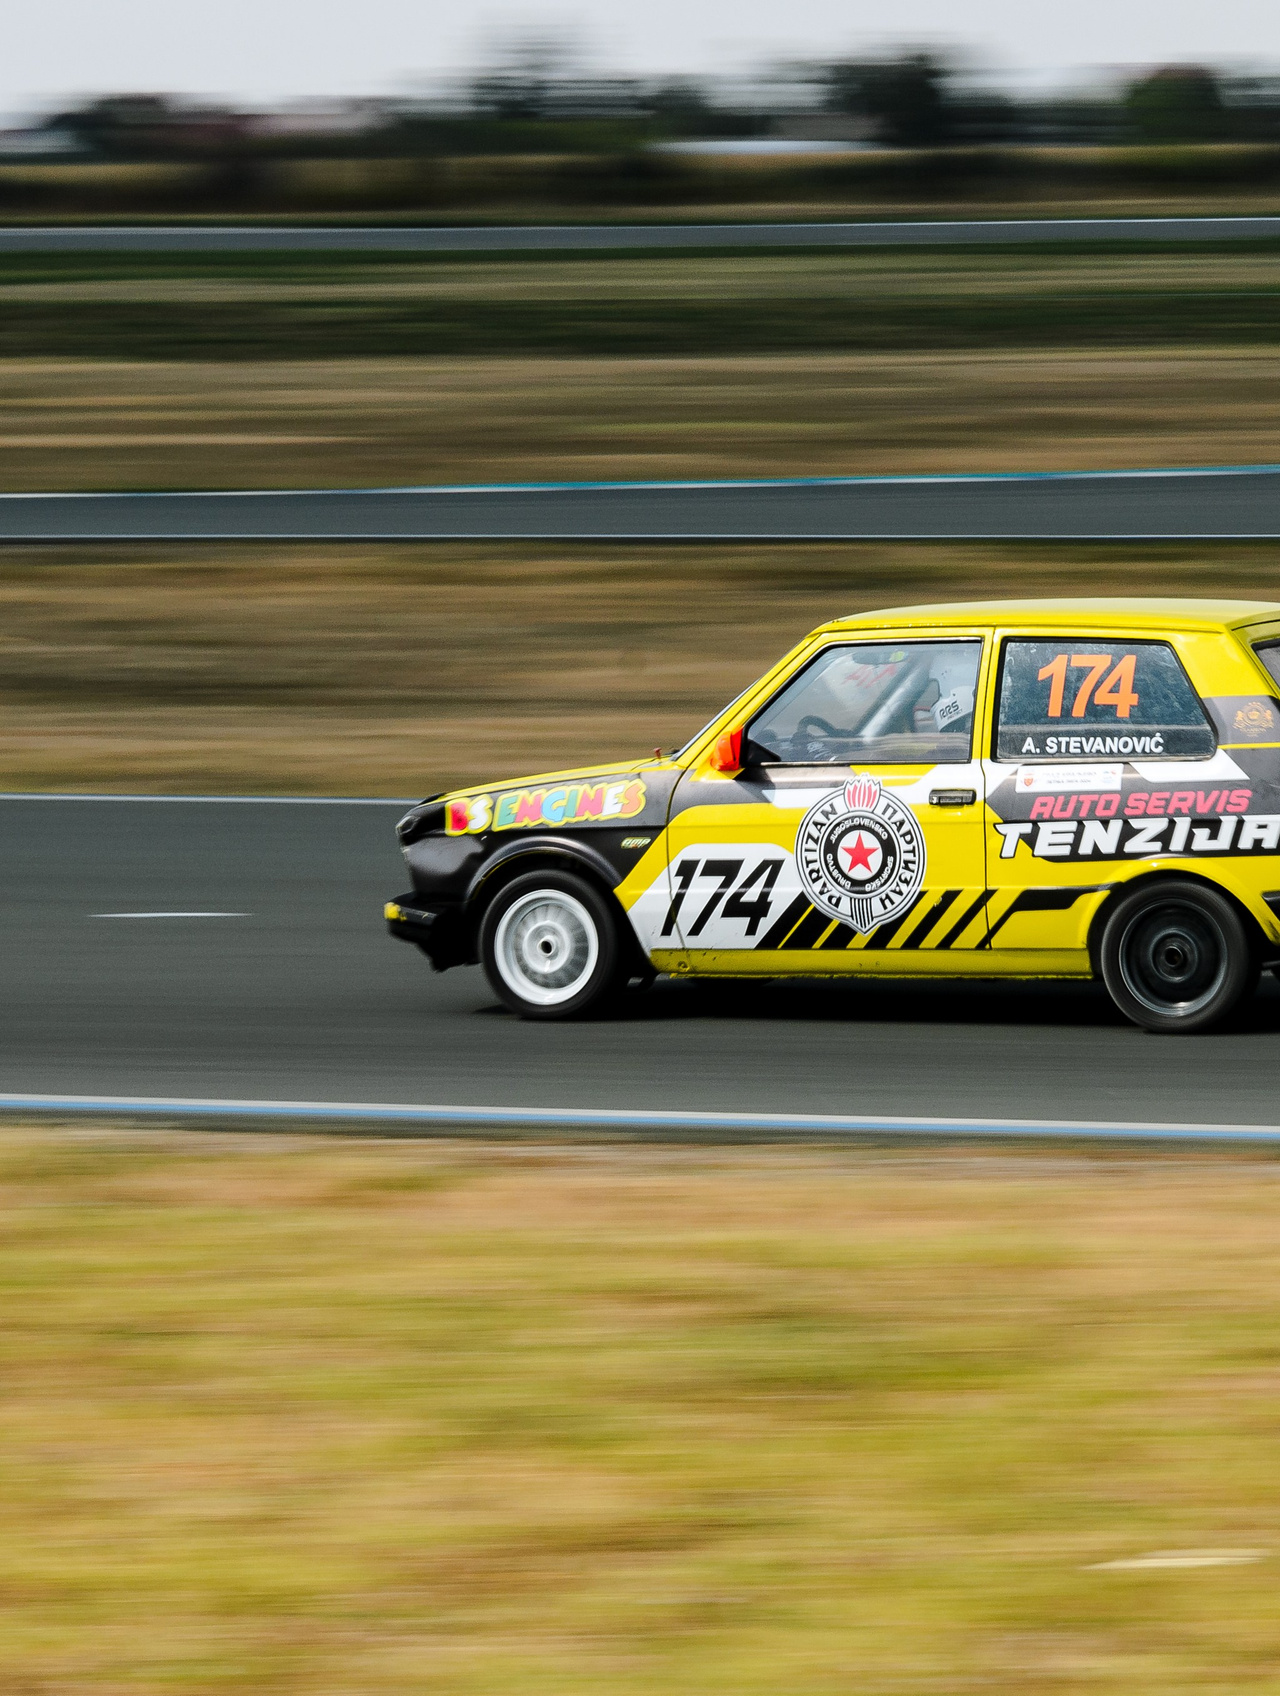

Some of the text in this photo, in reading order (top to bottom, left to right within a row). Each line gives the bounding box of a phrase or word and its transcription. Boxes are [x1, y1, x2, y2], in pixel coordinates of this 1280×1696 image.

[1037, 654, 1139, 718] 174
[939, 700, 960, 719] RRS
[1021, 732, 1164, 754] A. STEVANOVIĆ
[446, 781, 645, 834] BS ENGINES
[1029, 789, 1253, 820] AUTO SERVIS
[829, 816, 889, 845] JUGOSLOVENSKO
[804, 802, 843, 910] PARTIZAN
[864, 855, 894, 892] SPORTSKO
[881, 802, 917, 911] ПАРТИЗАН
[659, 858, 786, 937] 174
